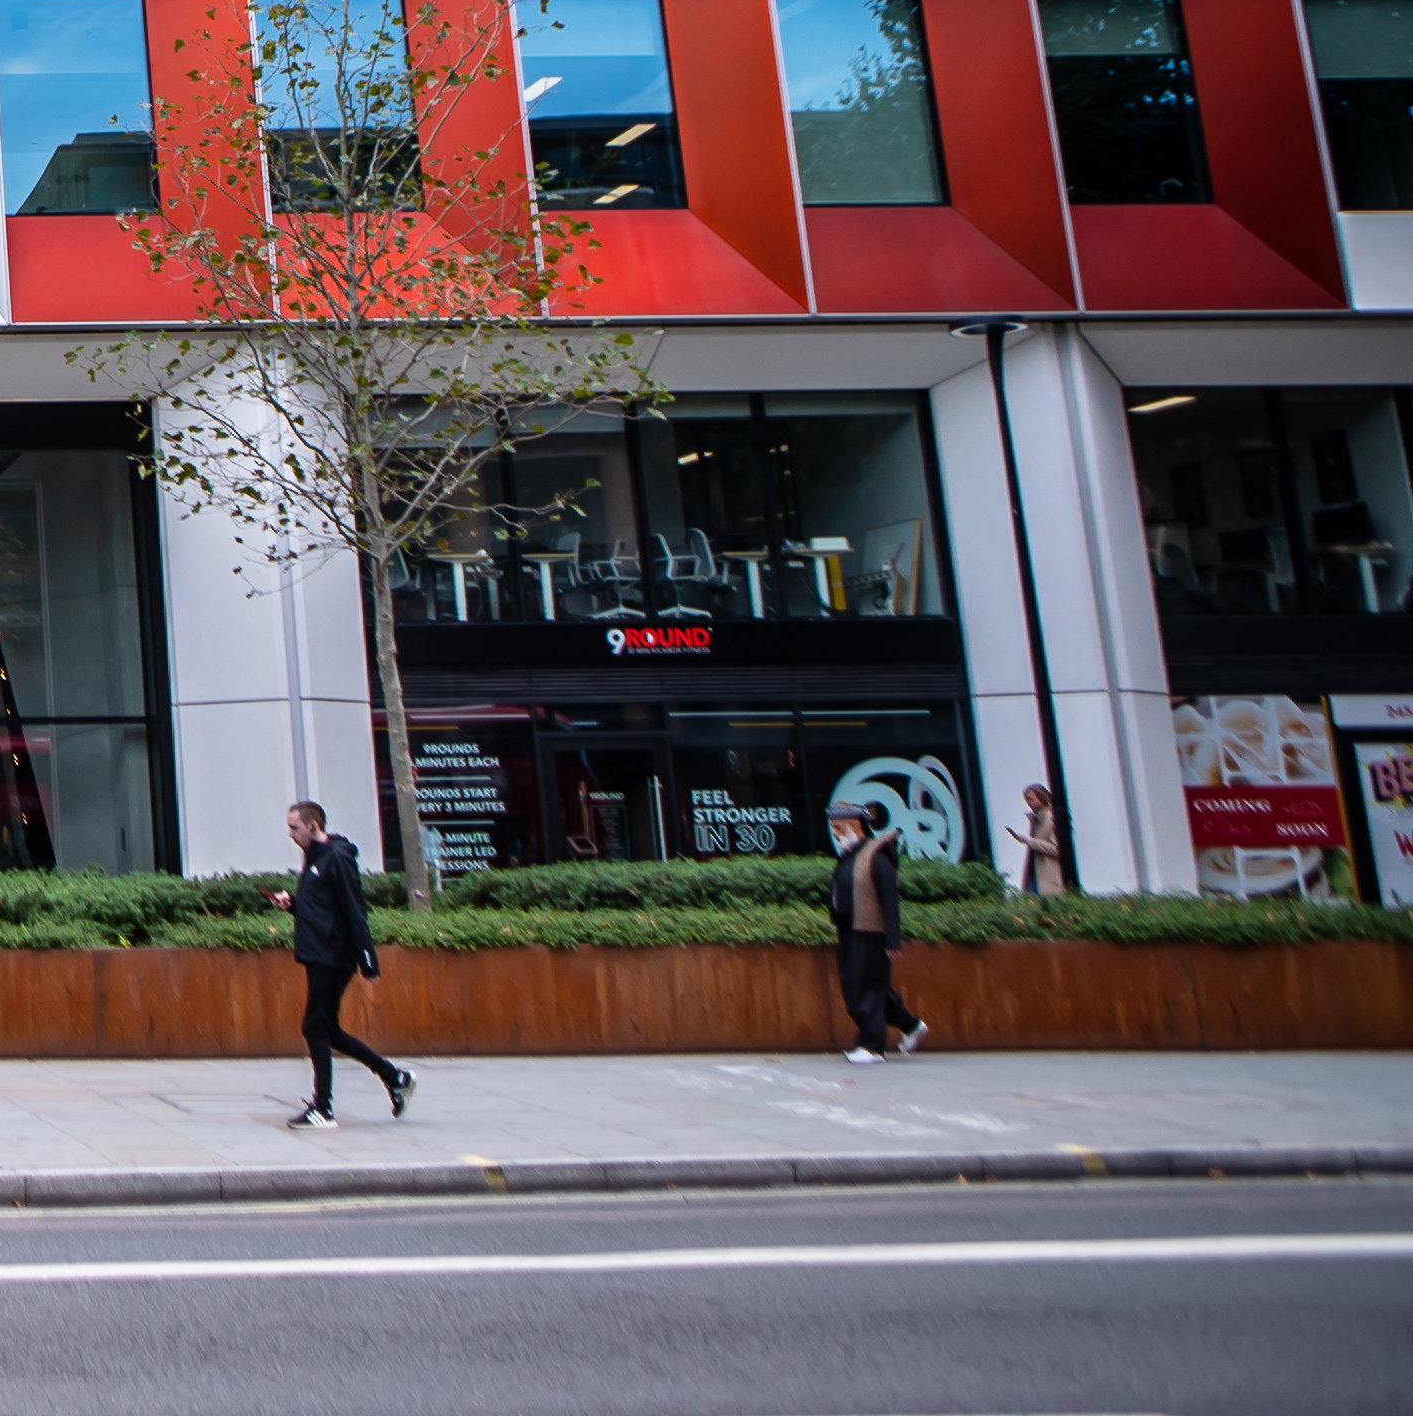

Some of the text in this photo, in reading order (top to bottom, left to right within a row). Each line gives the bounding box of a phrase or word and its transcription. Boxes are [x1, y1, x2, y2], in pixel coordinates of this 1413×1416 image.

[606, 626, 711, 656] 9ROUND
[414, 757, 500, 768] MINUTES EACH
[463, 788, 498, 799] START
[690, 789, 735, 806] FEEL
[454, 801, 507, 813] MINUTES
[1192, 797, 1274, 815] COMING
[692, 807, 793, 824] STRONGER
[695, 824, 776, 853] IN 30
[1275, 822, 1331, 839] SOON
[474, 847, 498, 857] LED
